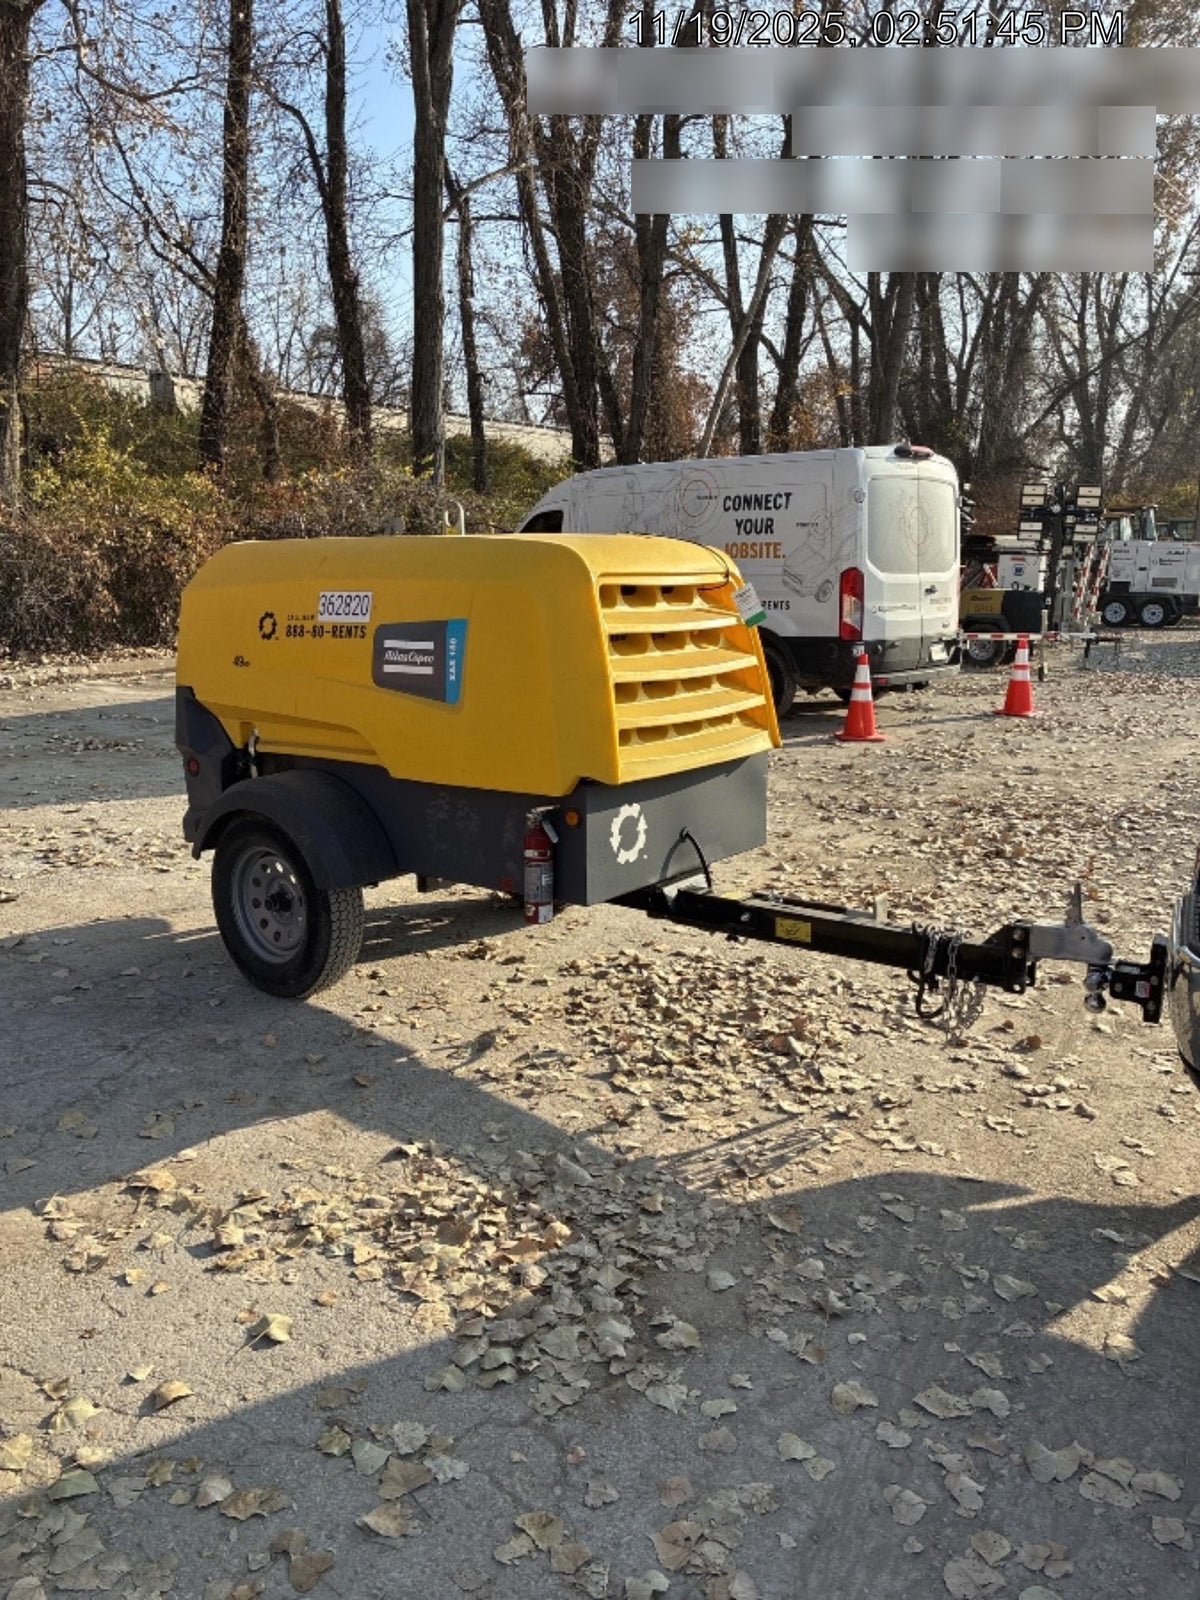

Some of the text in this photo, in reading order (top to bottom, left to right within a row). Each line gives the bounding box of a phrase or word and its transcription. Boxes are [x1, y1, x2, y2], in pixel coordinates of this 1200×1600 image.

[722, 492, 792, 512] CONNECT
[735, 517, 774, 536] YOUR
[319, 593, 370, 616] 362820
